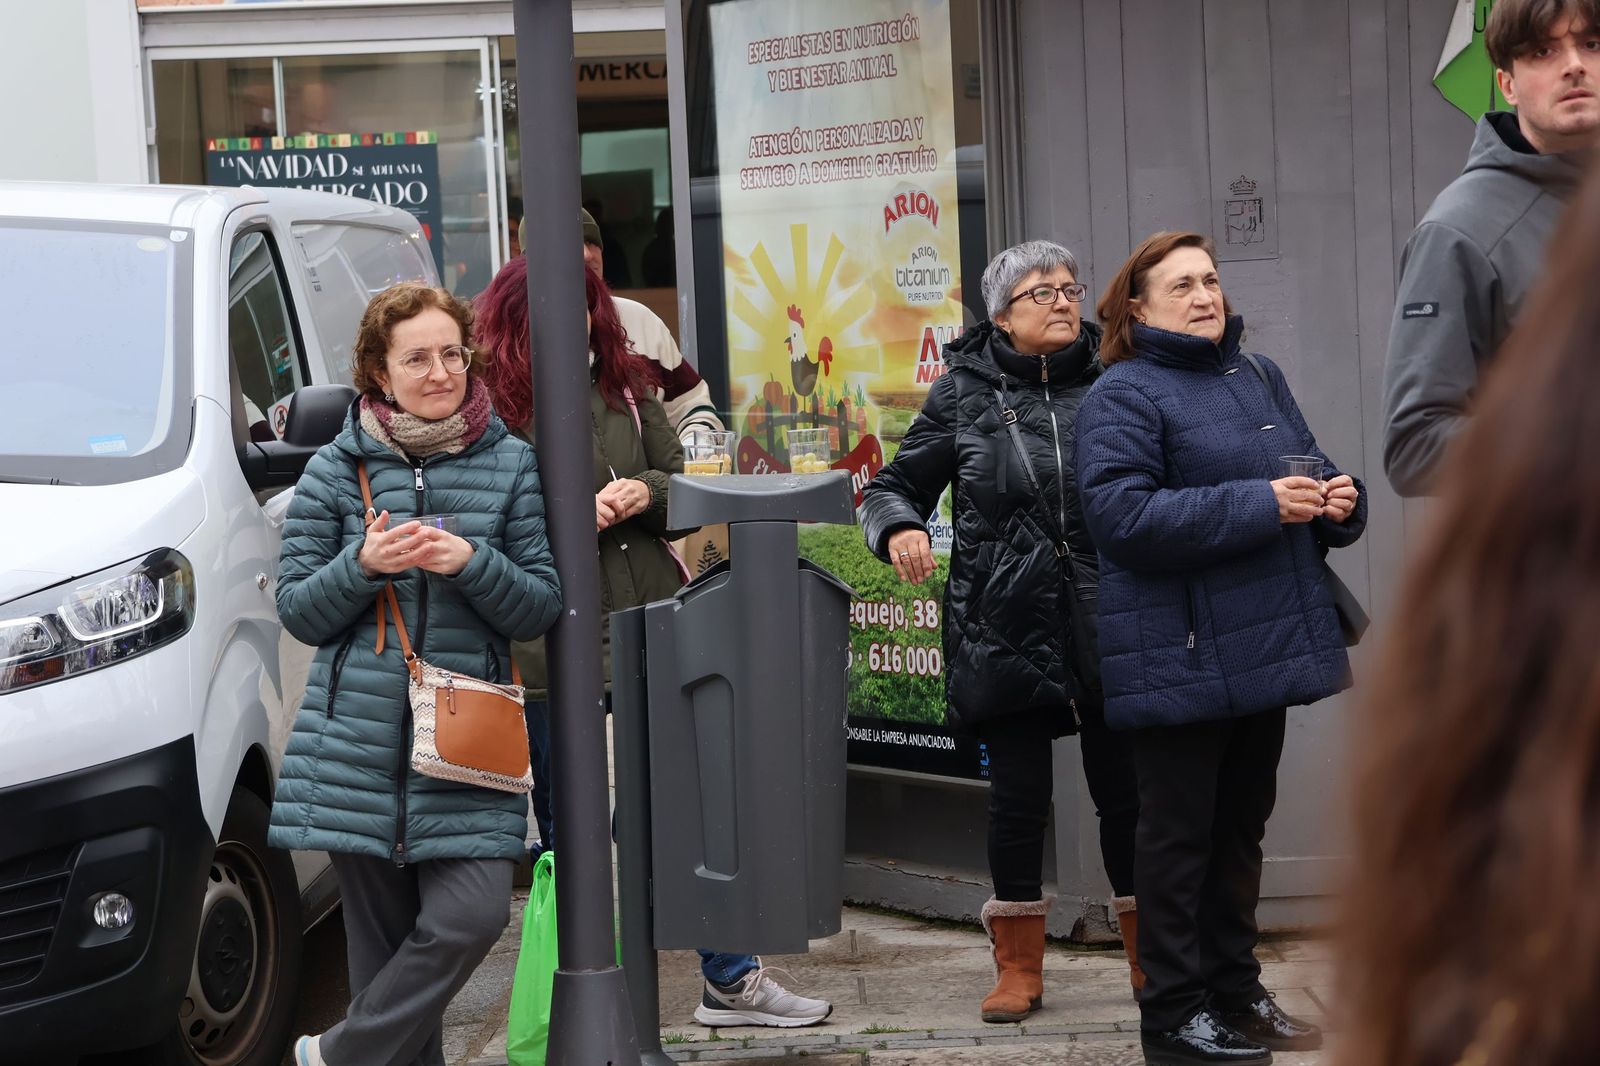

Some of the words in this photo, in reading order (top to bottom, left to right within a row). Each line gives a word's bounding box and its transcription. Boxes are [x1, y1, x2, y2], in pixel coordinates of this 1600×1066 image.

[748, 30, 832, 65] ESPECIALISTAS
[833, 27, 851, 53] EN
[853, 13, 920, 49] NUTRICIÓN
[767, 70, 777, 93] Y
[778, 61, 847, 92] BIENESTAR
[849, 54, 897, 83] ANIMAL
[749, 126, 813, 158] ATENCIÓN
[815, 118, 913, 152] PERSONALIZADA
[914, 116, 924, 140] Y
[220, 156, 235, 168] LA
[236, 152, 348, 181] NAVIDAD
[370, 163, 423, 176] ADELANTA
[740, 163, 797, 190] SERVICIO
[799, 162, 811, 184] A
[811, 155, 874, 184] DOMICILIO
[875, 144, 938, 177] GRATUÍTO
[883, 191, 940, 234] ARION
[911, 245, 938, 265] ARION
[895, 267, 951, 288] titanium
[912, 599, 939, 630] 38
[868, 642, 902, 674] 616
[906, 646, 941, 677] 000
[872, 729, 881, 743] LA
[881, 730, 908, 746] EMPRESA
[908, 733, 956, 751] ANUNCIADORA
